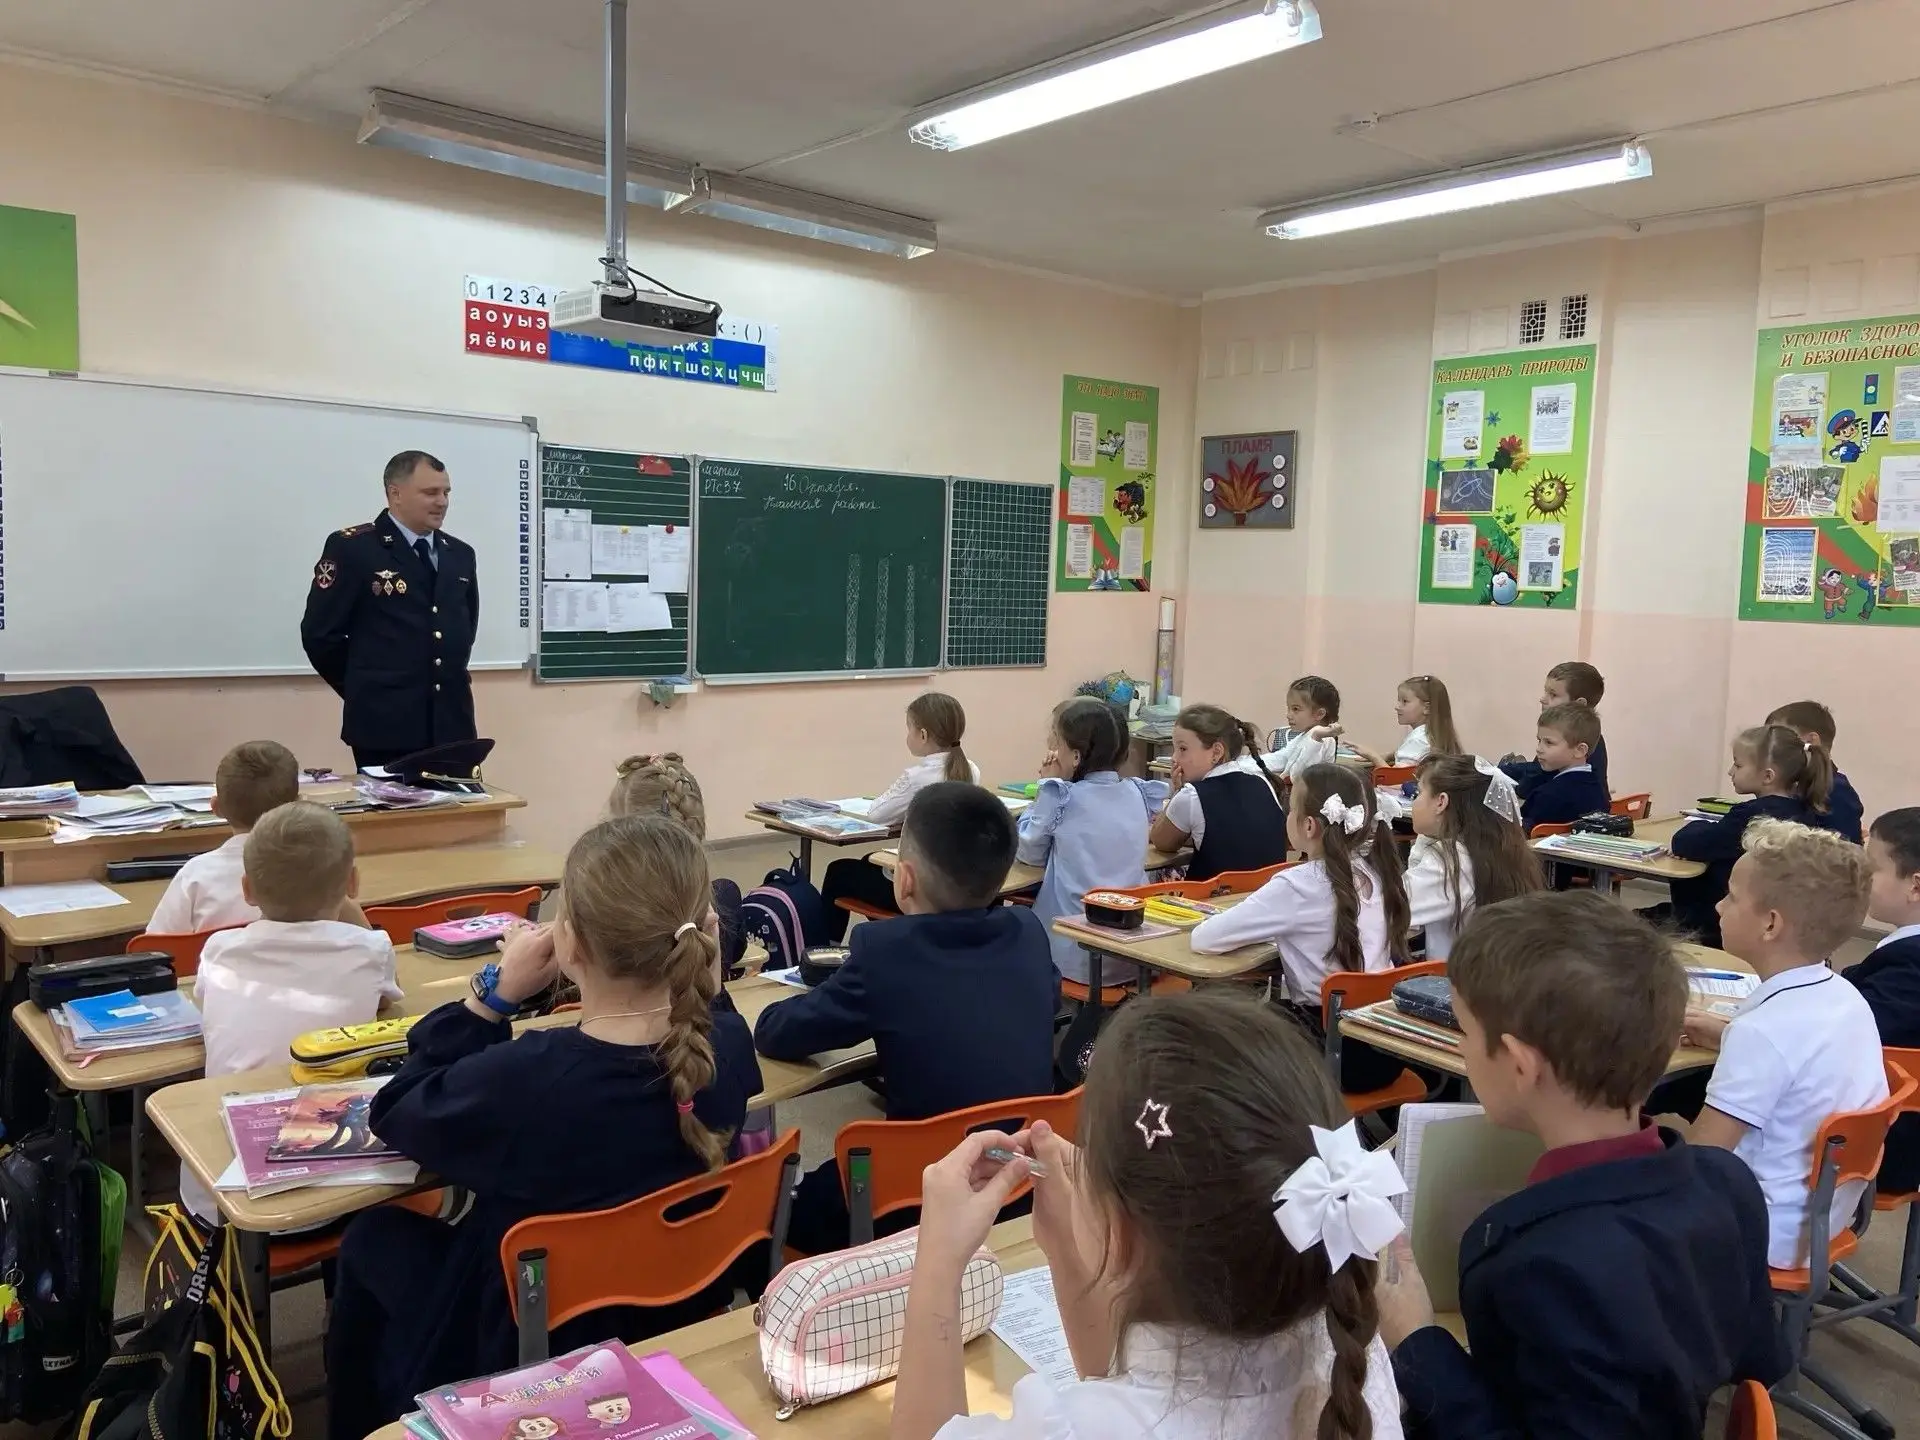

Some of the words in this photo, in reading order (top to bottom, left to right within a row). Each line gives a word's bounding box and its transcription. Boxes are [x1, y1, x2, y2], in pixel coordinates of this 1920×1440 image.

[1782, 328, 1852, 349] УГОЛОК
[1780, 352, 1794, 367] И
[1436, 364, 1513, 384] КАЛЕНДАРЬ
[1520, 356, 1589, 376] ПРИРОДЫ
[1221, 438, 1273, 455] ПЛАМЯ
